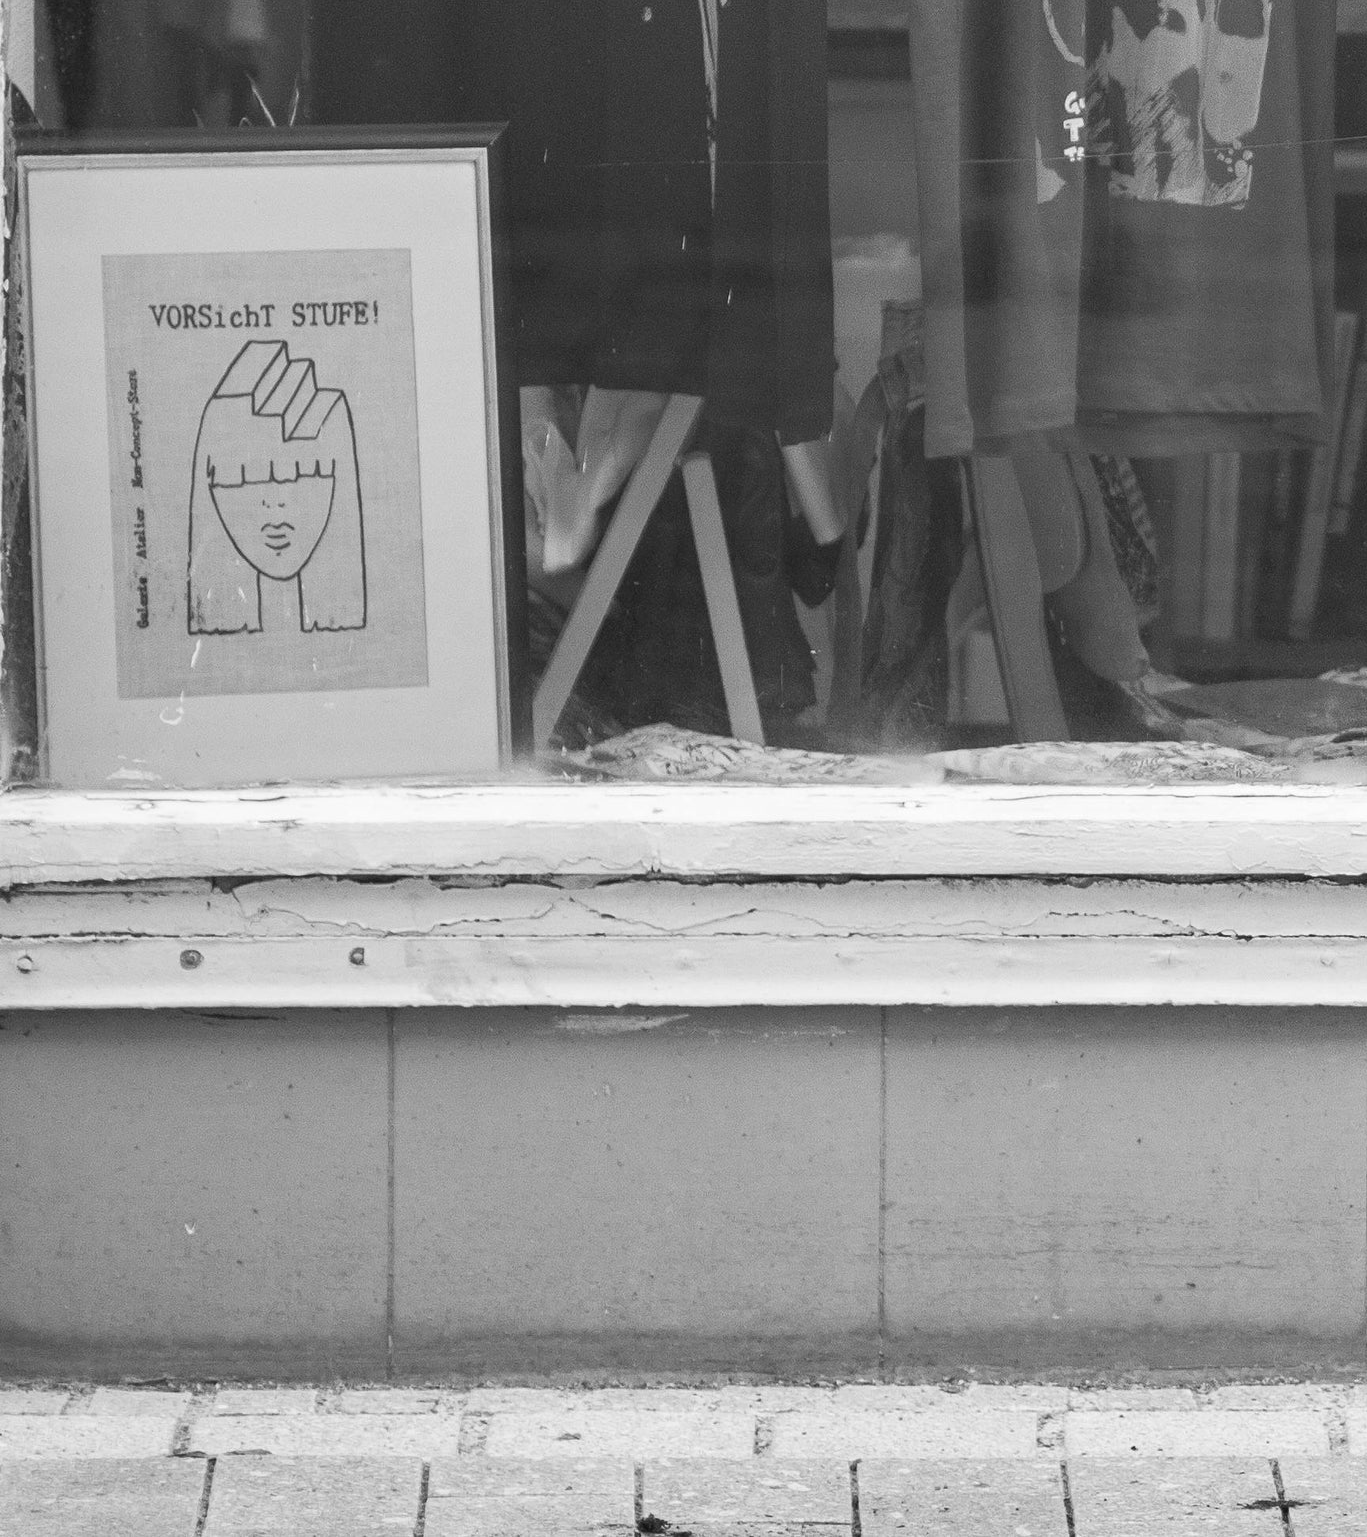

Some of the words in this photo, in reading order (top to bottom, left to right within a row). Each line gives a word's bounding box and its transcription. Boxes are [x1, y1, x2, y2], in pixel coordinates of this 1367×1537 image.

[148, 303, 276, 330] VORSichT
[291, 300, 379, 328] STUFE!
[133, 507, 148, 560] Atelier
